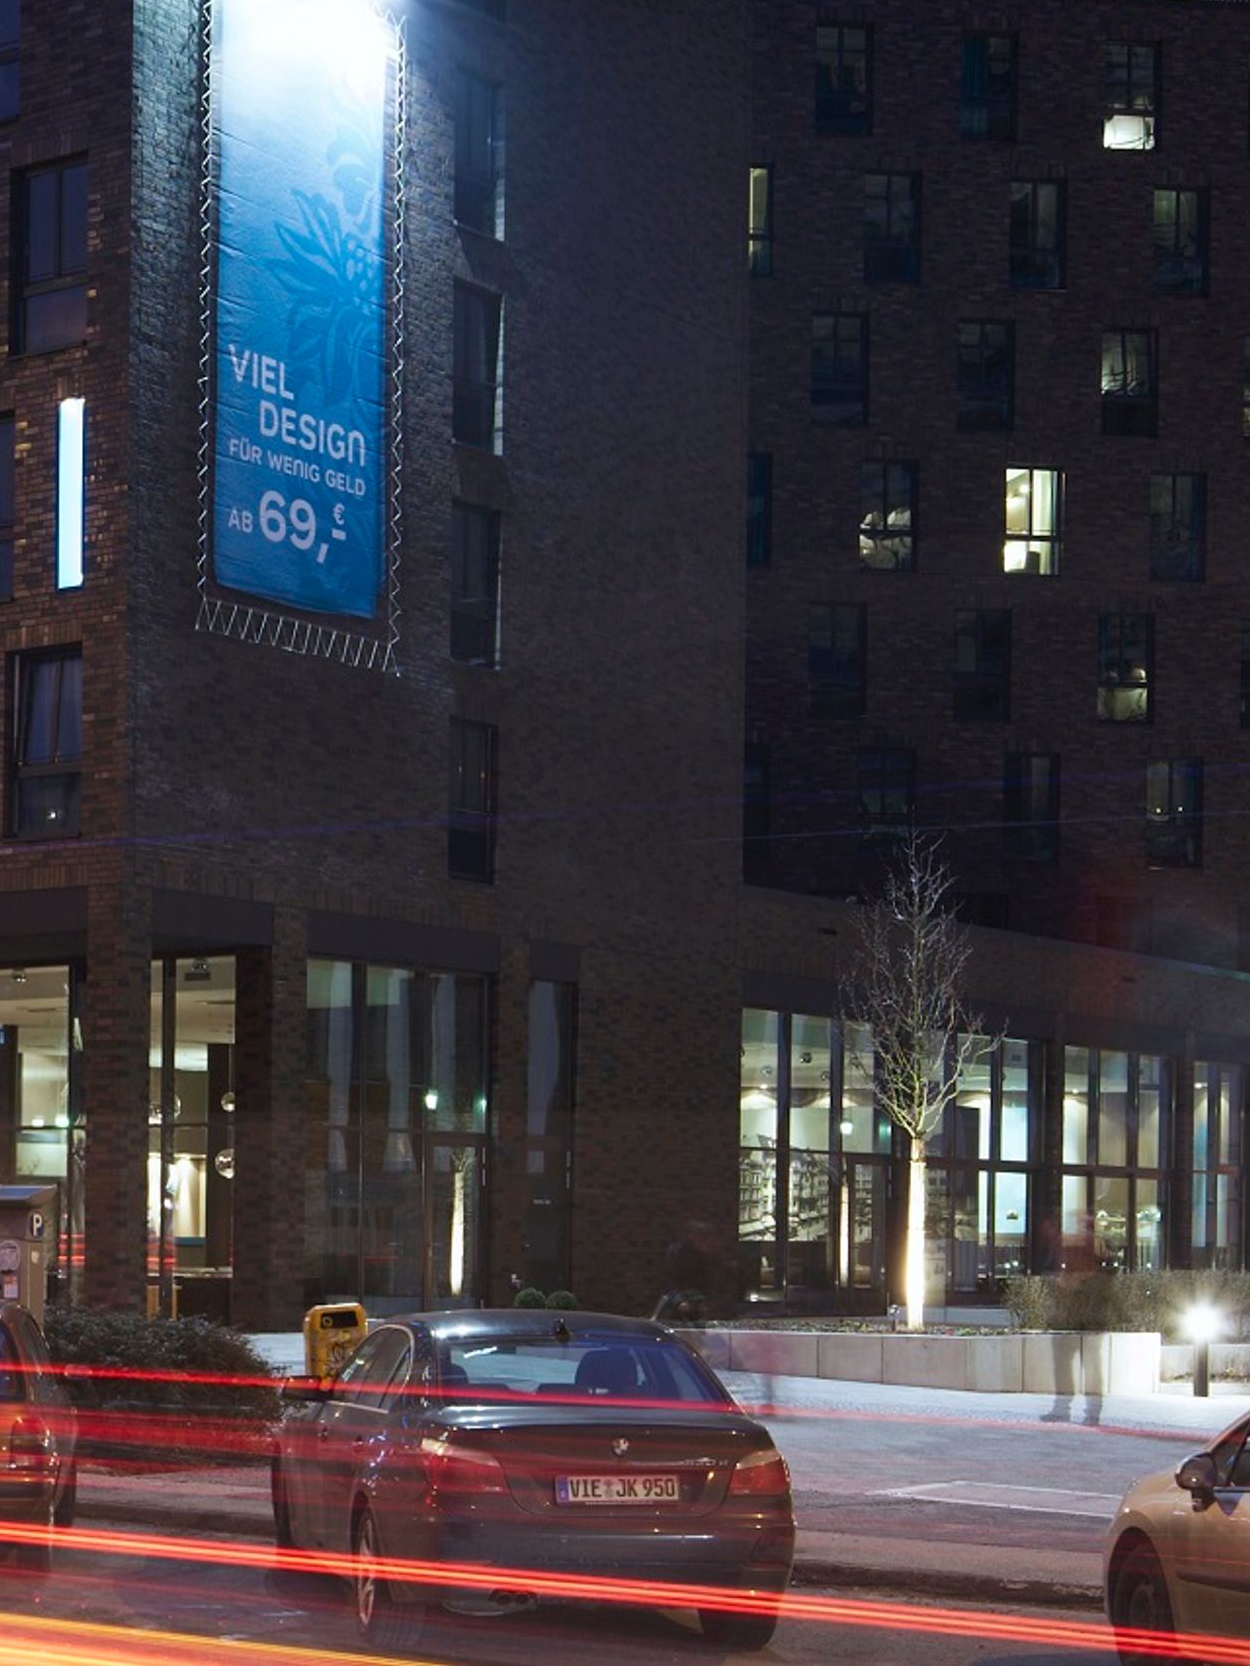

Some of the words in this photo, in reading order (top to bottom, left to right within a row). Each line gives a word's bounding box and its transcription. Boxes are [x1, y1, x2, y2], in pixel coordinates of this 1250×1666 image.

[229, 344, 295, 401] VIEL
[230, 437, 263, 465] FÜR
[325, 469, 366, 498] GELD
[229, 507, 253, 533] AB
[33, 1214, 43, 1237] P
[570, 1478, 602, 1498] VIE
[615, 1478, 639, 1498] JK
[643, 1478, 676, 1498] 950
